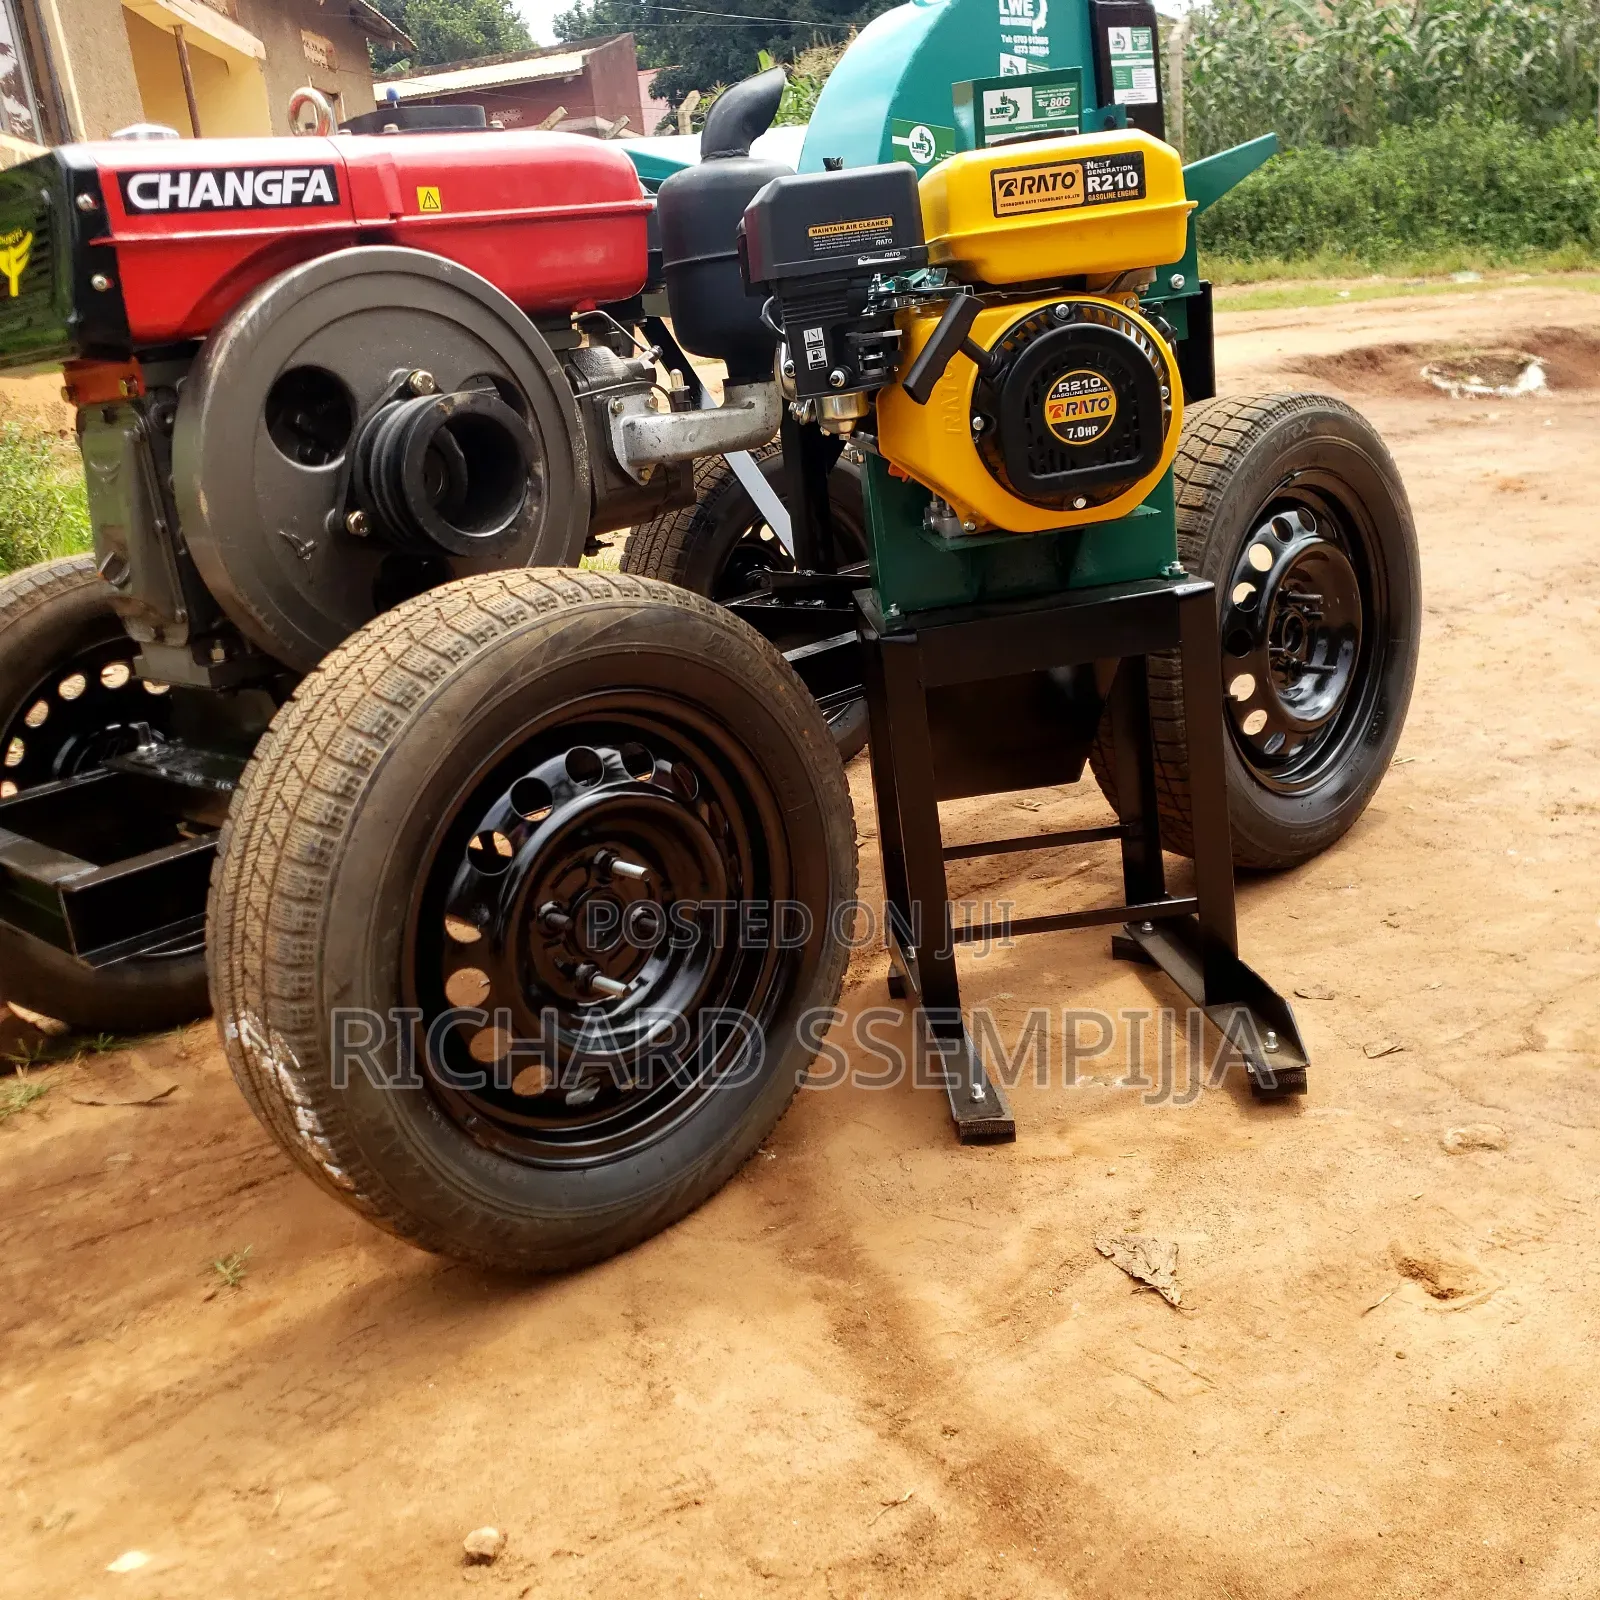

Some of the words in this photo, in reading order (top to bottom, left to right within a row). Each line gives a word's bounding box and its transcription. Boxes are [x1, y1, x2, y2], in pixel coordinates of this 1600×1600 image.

[999, 0, 1034, 17] LWE
[1050, 96, 1071, 107] 80G
[989, 106, 1011, 115] LWE
[912, 141, 927, 151] LWE
[1087, 165, 1133, 176] GENERATION
[127, 168, 334, 210] CHANGFA
[1019, 171, 1076, 195] RATO
[1087, 171, 1139, 193] R210
[1088, 191, 1117, 202] GASOLINE
[1117, 188, 1139, 198] ENGINE
[812, 225, 845, 235] MAINTAIN
[859, 219, 889, 229] CLEANER
[875, 238, 893, 246] RATO
[1058, 377, 1101, 393] R210
[1052, 390, 1084, 399] GASOLINE
[1084, 386, 1108, 394] ENGINE
[1066, 397, 1110, 417] RATO
[1067, 425, 1099, 439] 7.0HP
